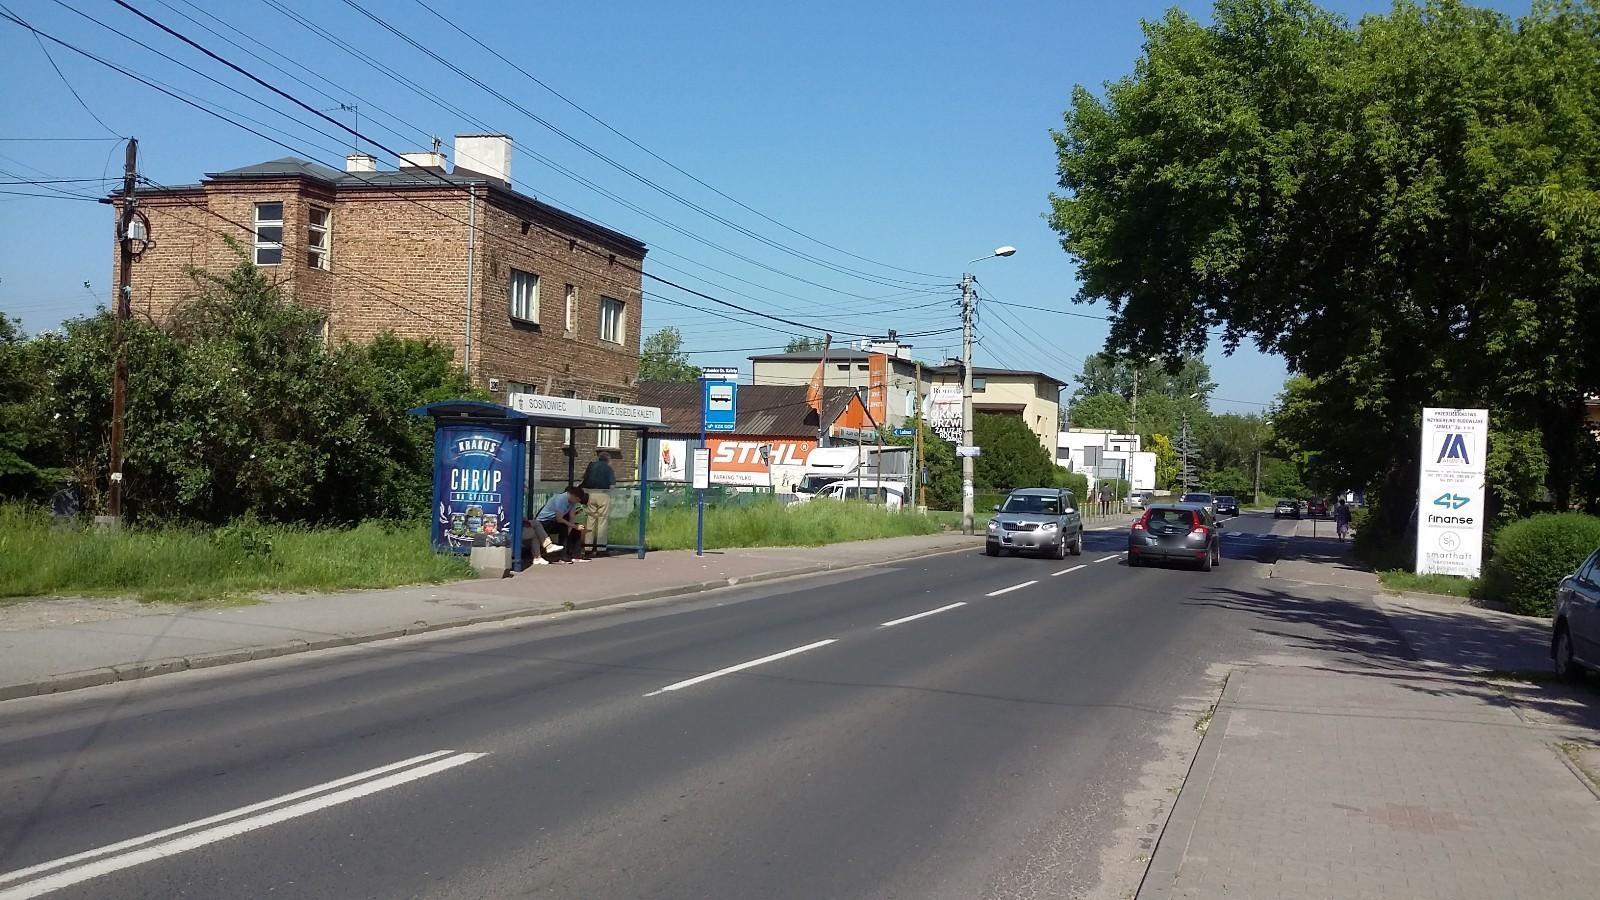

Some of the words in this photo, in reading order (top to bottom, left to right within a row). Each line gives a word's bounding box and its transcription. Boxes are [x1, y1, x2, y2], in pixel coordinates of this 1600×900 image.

[529, 398, 567, 412] SOSNOWIEC
[615, 407, 637, 418] OSIEDLE
[637, 409, 655, 419] KALETY
[930, 409, 963, 419] OKNA
[931, 419, 963, 428] DRZWI
[458, 440, 497, 453] KRAKUS
[713, 441, 803, 465] STIHL
[451, 468, 502, 492] CHRUP
[1428, 514, 1473, 524] finanse
